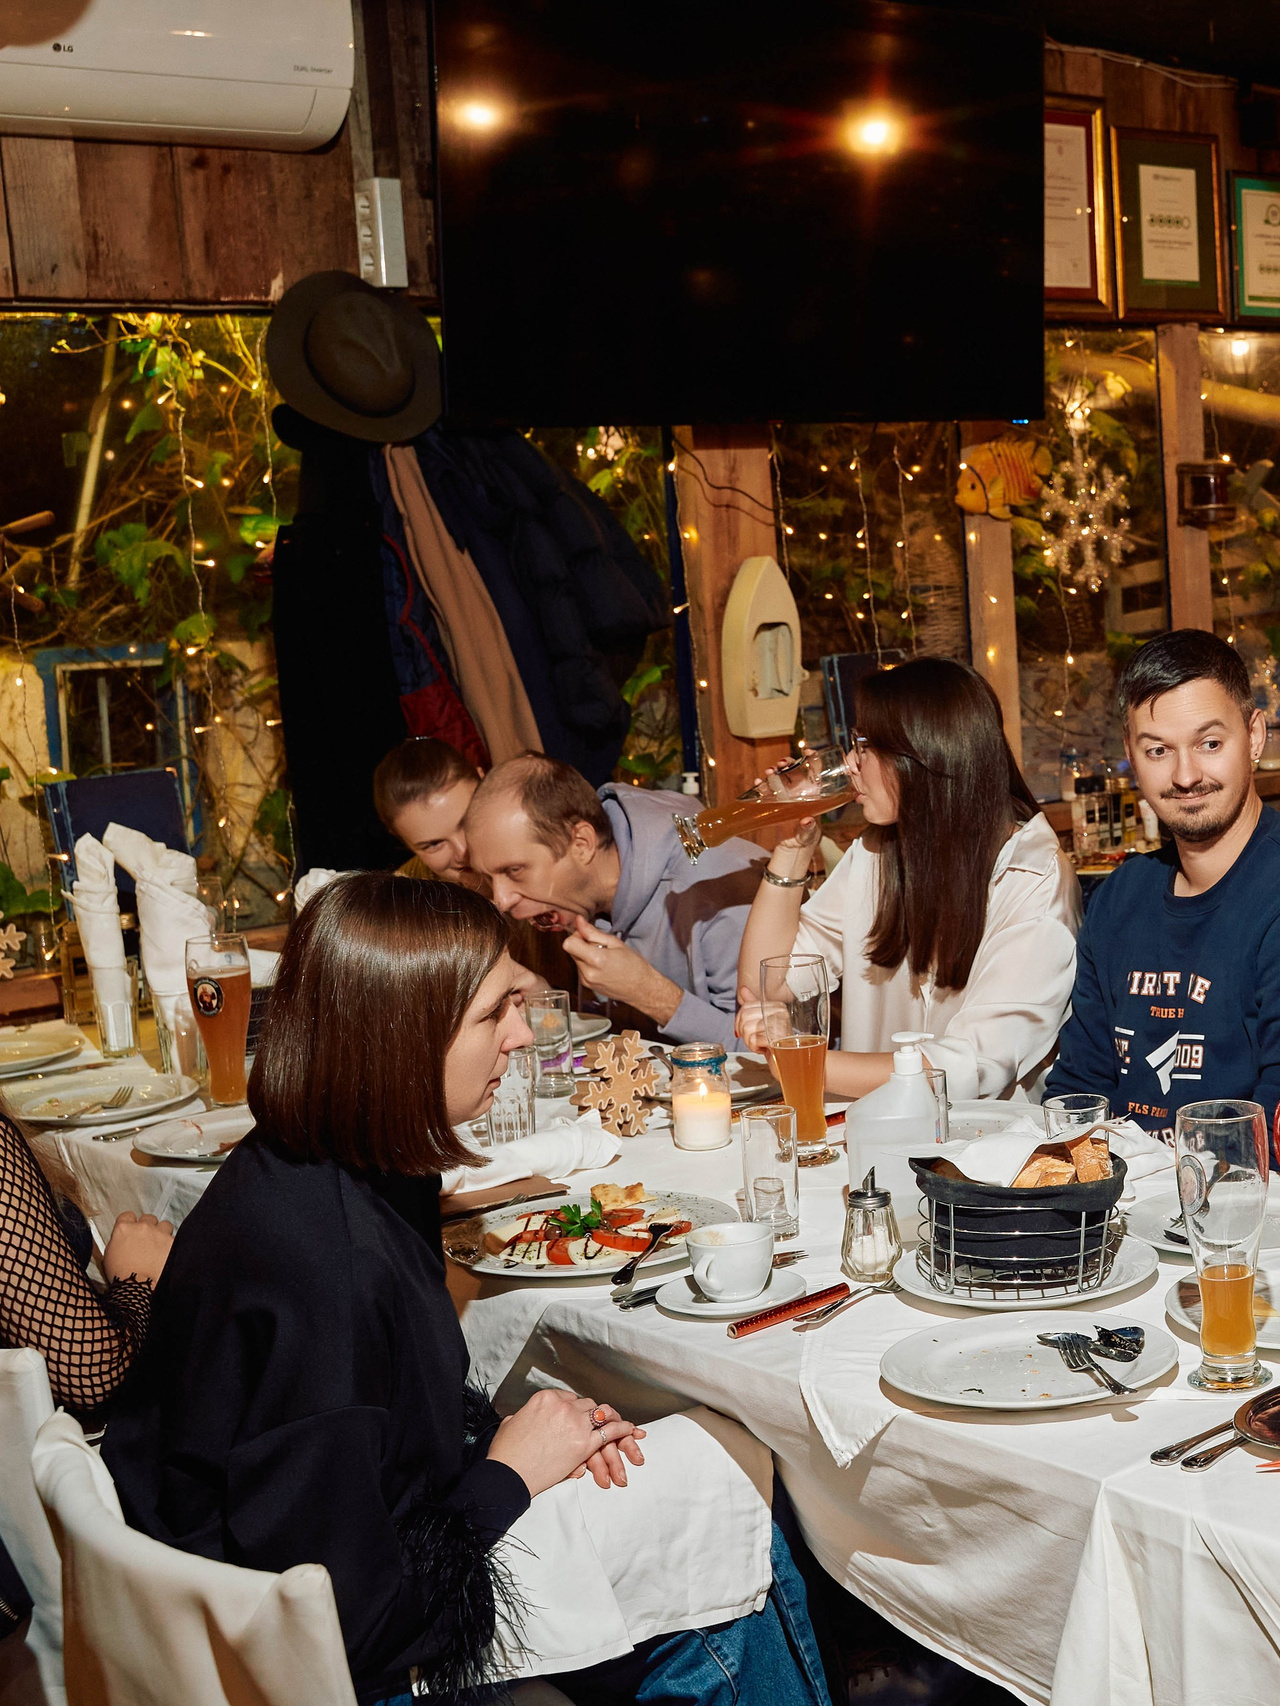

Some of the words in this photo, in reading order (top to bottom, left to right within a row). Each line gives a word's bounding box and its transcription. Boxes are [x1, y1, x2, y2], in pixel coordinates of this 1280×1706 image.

[63, 44, 74, 53] LG
[1150, 1005, 1176, 1019] TRUE
[1128, 1101, 1150, 1115] FLS
